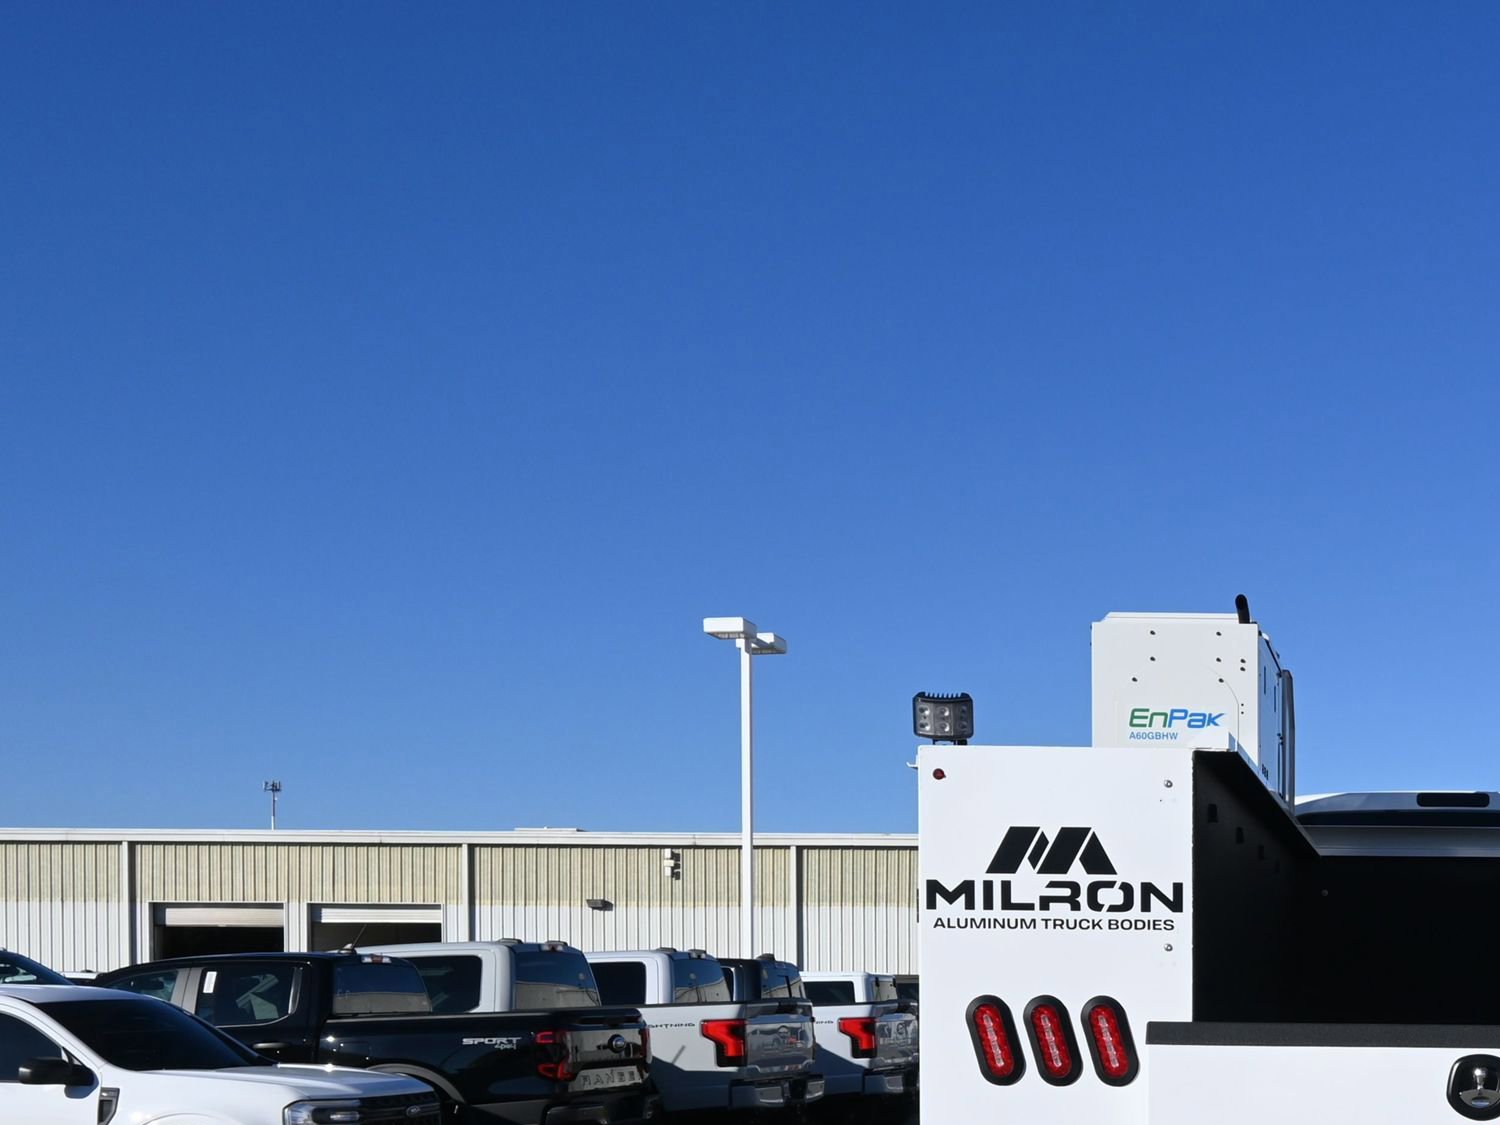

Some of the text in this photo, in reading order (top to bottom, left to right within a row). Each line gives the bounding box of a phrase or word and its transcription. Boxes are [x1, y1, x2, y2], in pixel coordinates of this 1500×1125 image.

[1129, 708, 1225, 729] EnPak
[1129, 731, 1178, 740] A60GBHW
[926, 879, 1184, 914] MILRON
[933, 917, 1175, 931] ALUMINUM TRUCK BODIES
[462, 1037, 522, 1045] SPORT
